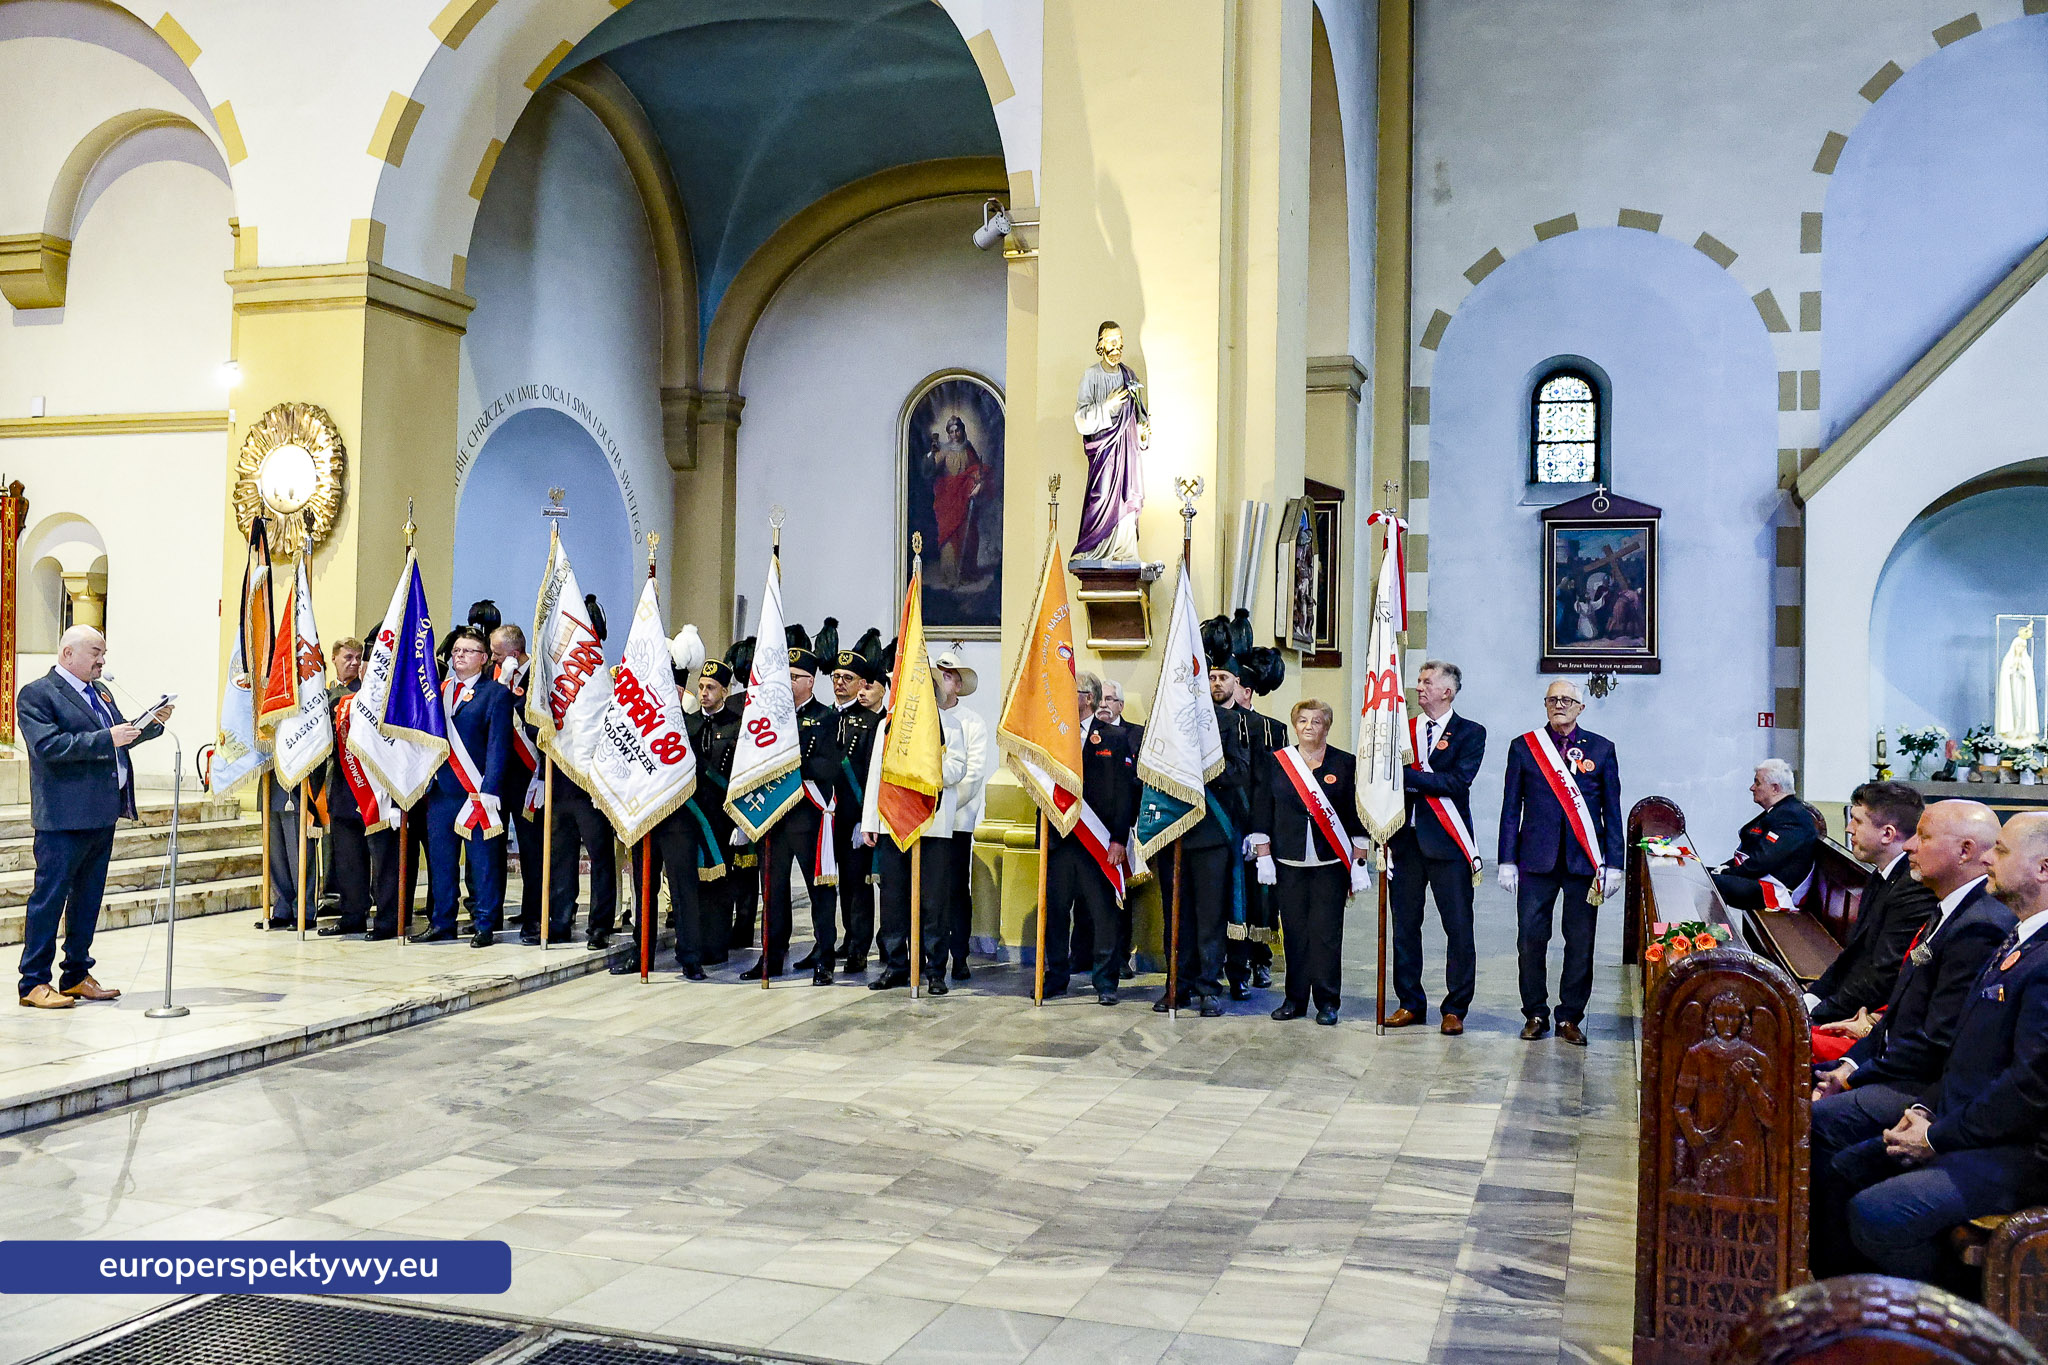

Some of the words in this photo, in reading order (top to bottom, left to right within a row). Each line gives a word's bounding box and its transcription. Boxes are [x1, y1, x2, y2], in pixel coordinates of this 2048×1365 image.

[505, 388, 516, 406] W
[542, 384, 565, 405] OJCA
[572, 397, 592, 424] SYNA
[597, 423, 622, 469] DUCHA
[417, 664, 438, 703] HUTA
[747, 717, 778, 748] 80
[897, 693, 920, 757] ZWIĄZEK
[650, 731, 687, 765] 80
